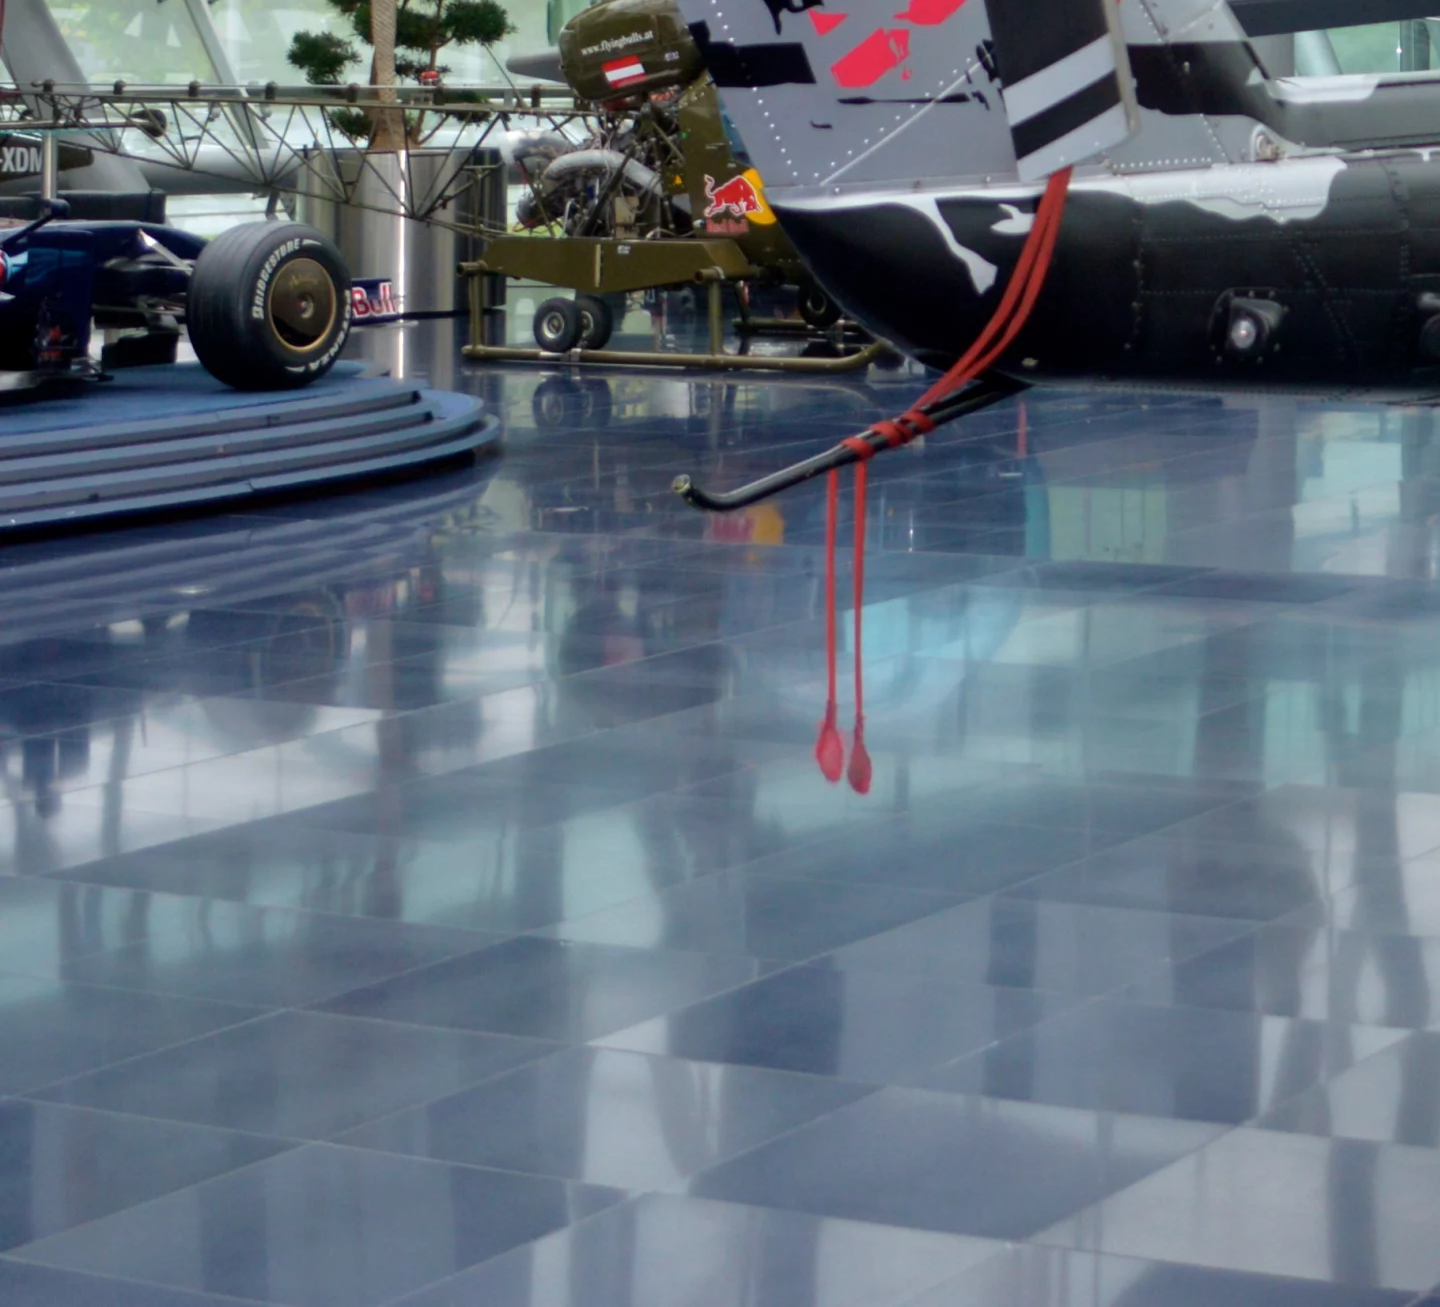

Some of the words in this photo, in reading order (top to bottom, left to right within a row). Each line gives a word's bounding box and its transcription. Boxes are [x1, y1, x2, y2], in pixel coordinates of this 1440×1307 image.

[580, 29, 654, 56] www.flyingbulls.at
[252, 238, 300, 319] BRIDGESTONE
[351, 282, 397, 318] Bull
